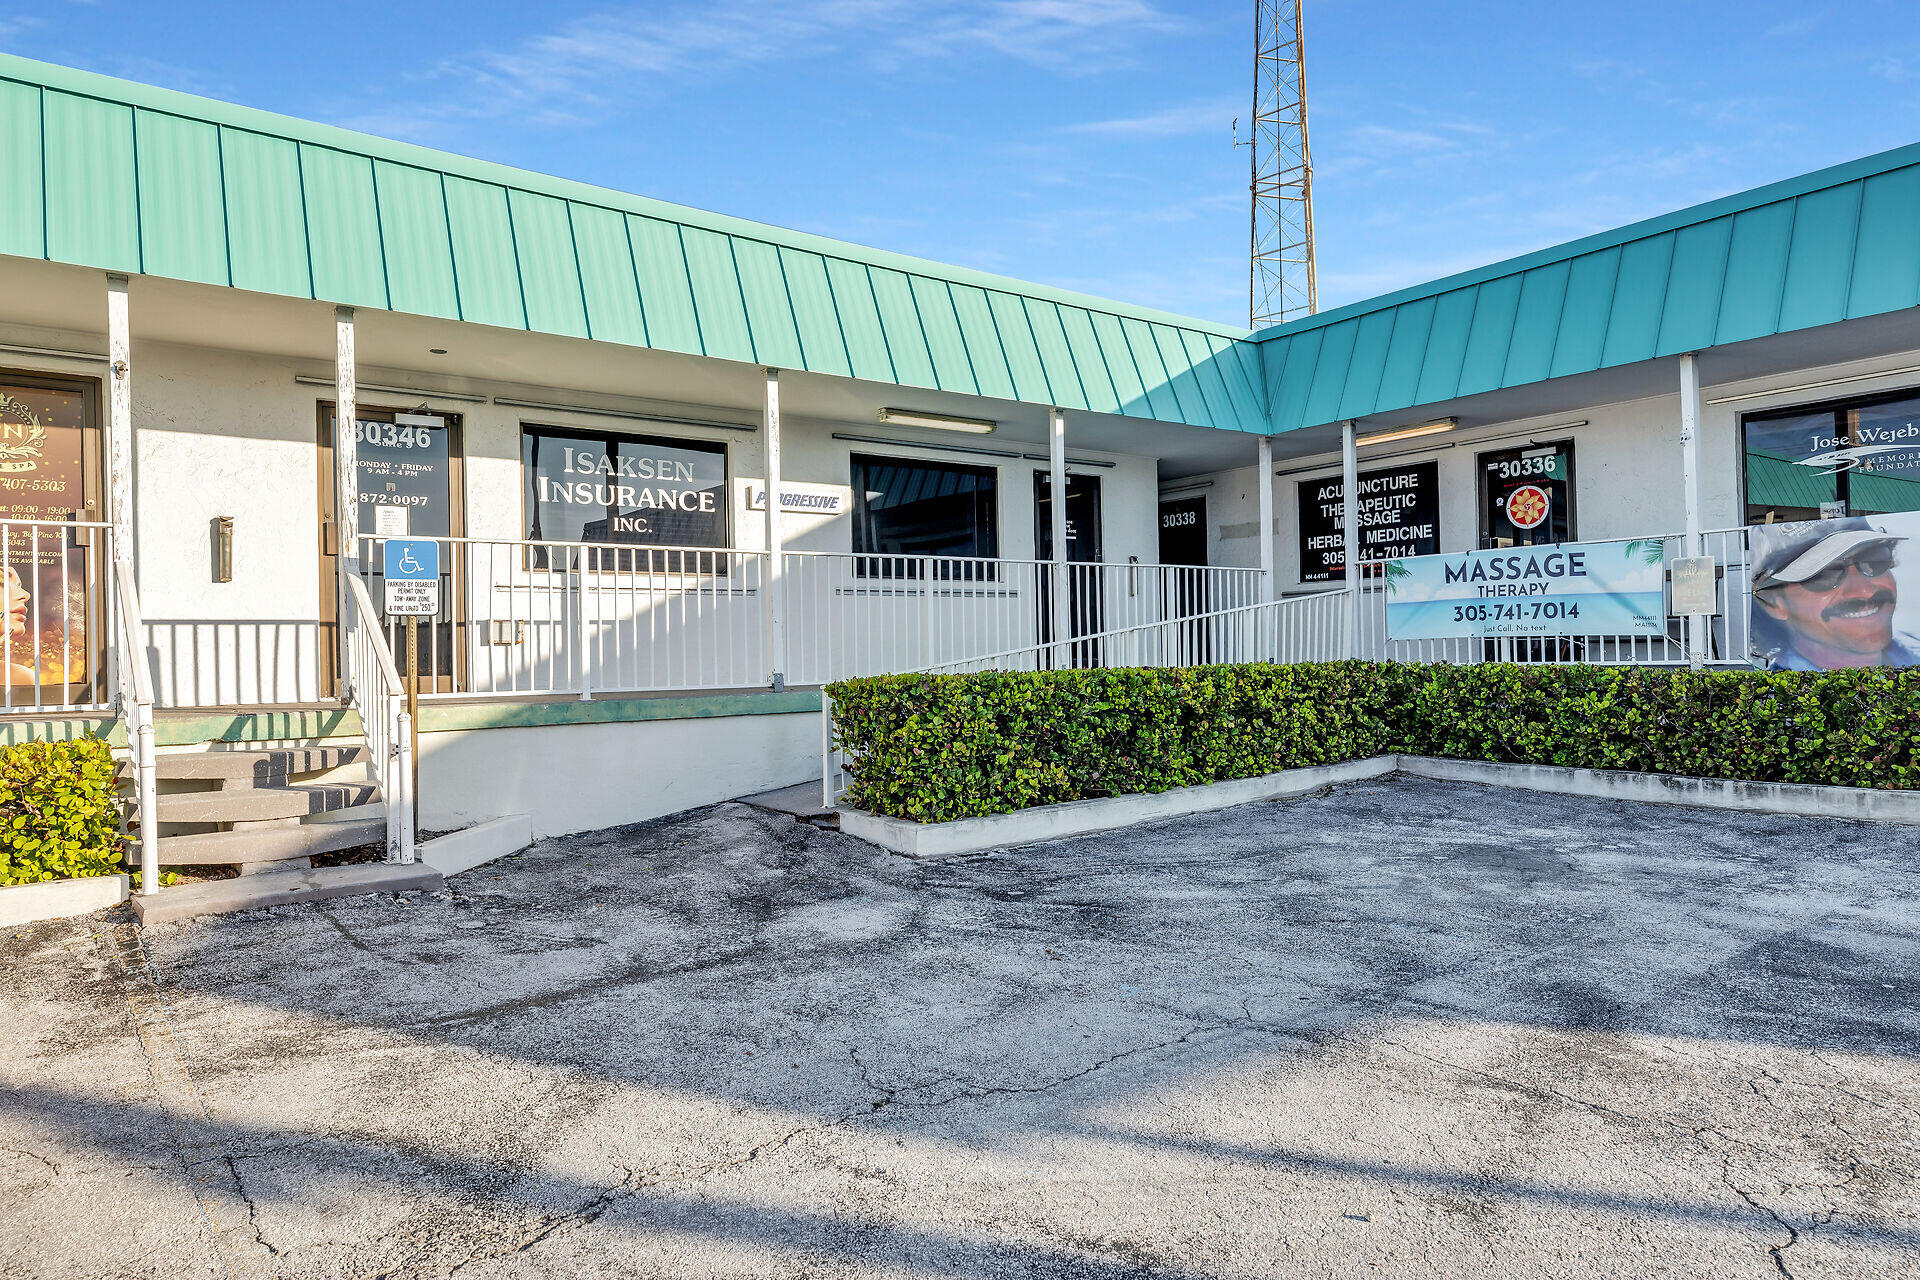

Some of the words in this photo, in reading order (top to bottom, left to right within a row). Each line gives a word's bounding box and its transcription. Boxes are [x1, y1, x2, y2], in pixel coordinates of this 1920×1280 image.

[355, 421, 431, 448] 30346
[1811, 435, 1850, 452] Jose
[1856, 422, 1919, 443] Wejeb
[12, 462, 33, 470] SPA
[355, 460, 391, 469] ONDAY
[401, 463, 434, 472] FRIDAY
[1499, 455, 1556, 478] 30336
[1859, 461, 1920, 474] FOUNDAT
[2, 477, 66, 492] 407-5303
[1317, 473, 1418, 501] ACUUNCTURE
[11, 504, 39, 513] 09:00
[47, 506, 71, 515] 19:00
[755, 491, 840, 509] PGRESSIVE
[1320, 493, 1416, 517] THEAPEUTIC
[613, 517, 653, 533] INC.
[1163, 511, 1196, 528] 30338
[1334, 509, 1401, 530] MSSAGE
[1307, 535, 1359, 550] HERB
[1367, 524, 1433, 544] MEDICINE
[1322, 544, 1416, 565] 30541-7014
[1445, 552, 1587, 584] MASSAGE
[1478, 582, 1549, 598] THERAPY
[1453, 602, 1580, 622] 305-741-7014
[1484, 626, 1495, 634] Just
[1516, 624, 1529, 632] No
[1531, 624, 1546, 632] text
